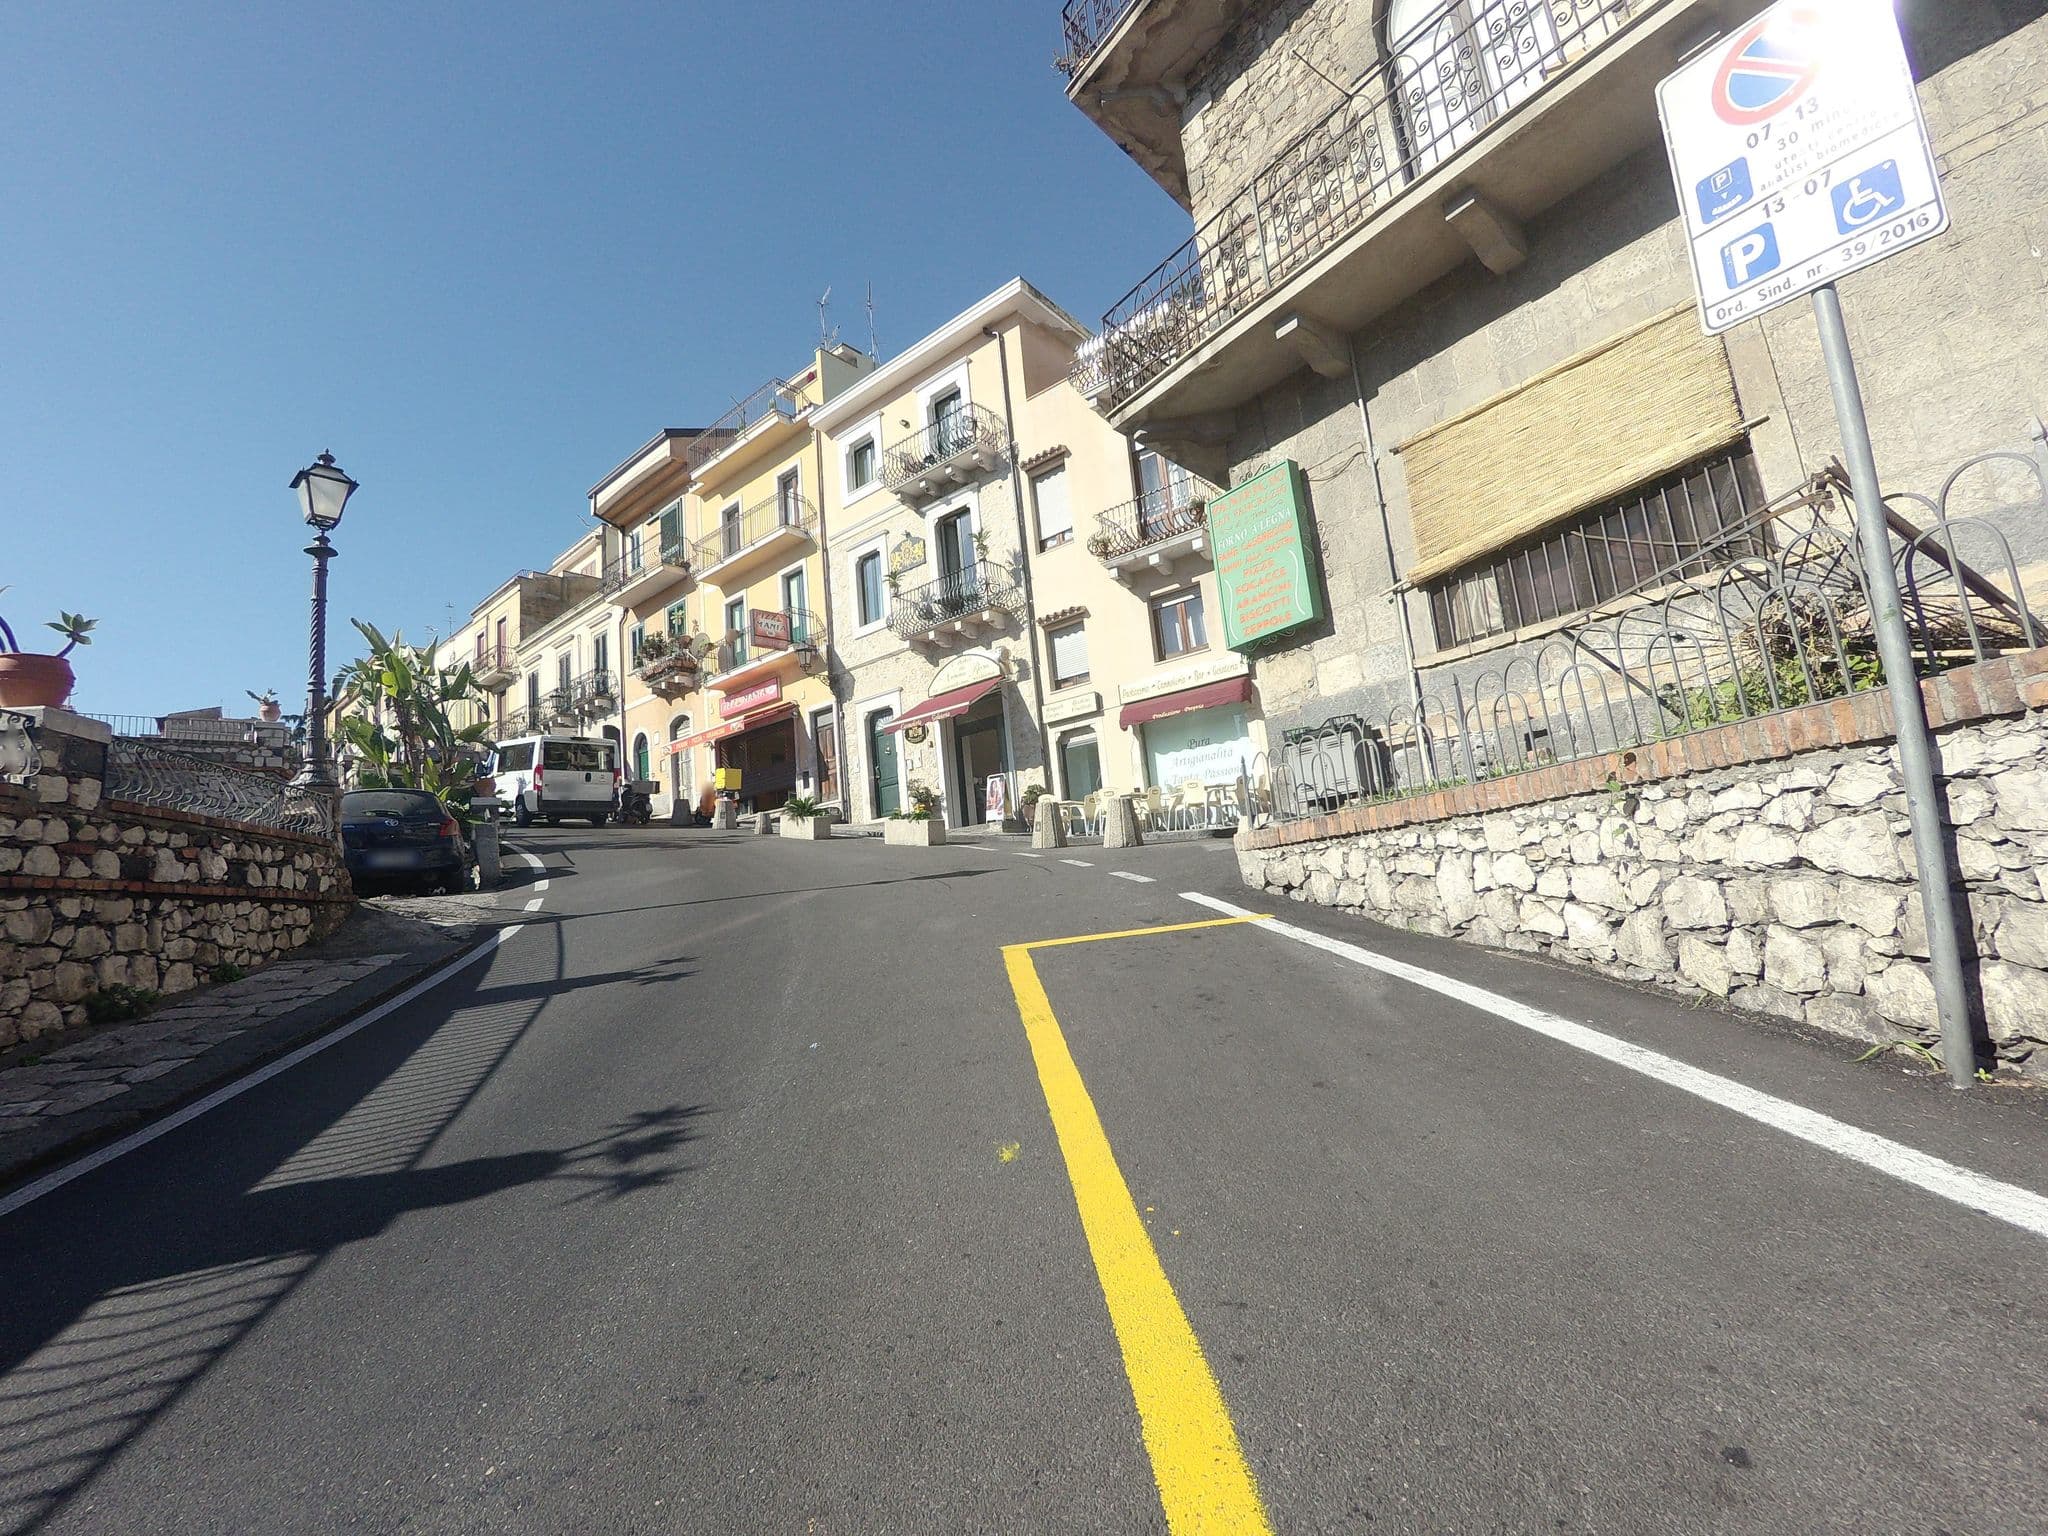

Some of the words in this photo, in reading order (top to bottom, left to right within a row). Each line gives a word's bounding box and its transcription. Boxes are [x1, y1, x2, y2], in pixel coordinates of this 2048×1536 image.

[1746, 123, 1772, 149] 07
[1795, 97, 1819, 121] 13
[1777, 131, 1799, 151] 30
[1804, 170, 1832, 196] 07
[1716, 302, 1748, 321] Ord.
[1757, 277, 1797, 302] Sind.
[1842, 212, 1931, 262] 39/2016
[1217, 529, 1248, 551] FORNO
[1260, 508, 1292, 532] LEGNA
[1187, 736, 1210, 749] Pura
